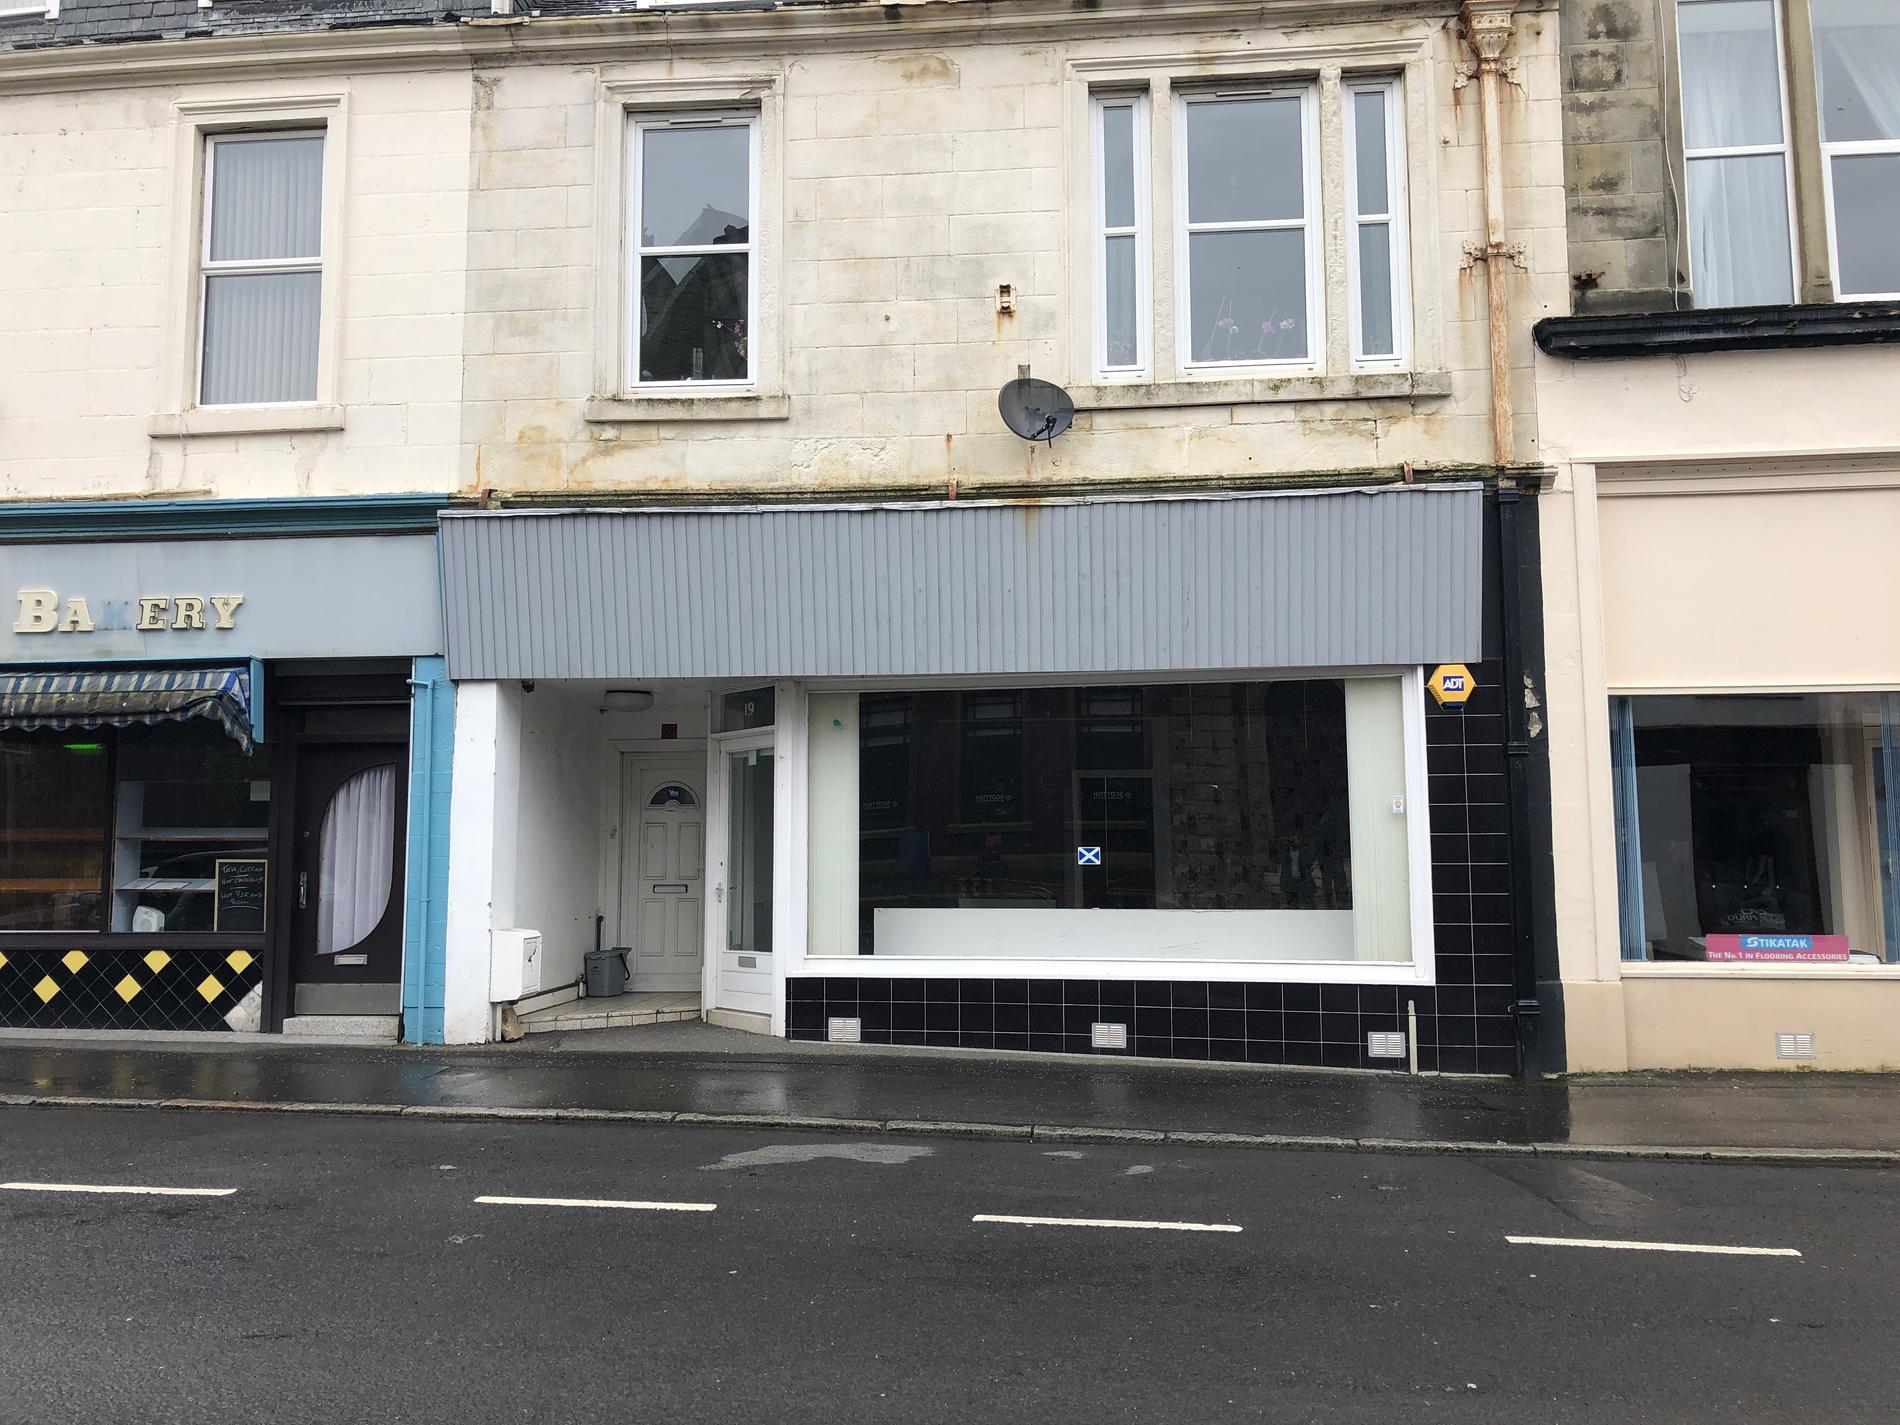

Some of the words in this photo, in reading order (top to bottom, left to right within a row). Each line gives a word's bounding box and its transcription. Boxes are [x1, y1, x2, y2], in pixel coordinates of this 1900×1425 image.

[1443, 678, 1464, 689] ADT
[744, 702, 755, 717] 19
[1746, 936, 1809, 949] STIKATAK
[1755, 952, 1794, 960] FLOORING
[1796, 952, 1848, 960] ACCESSORIES
